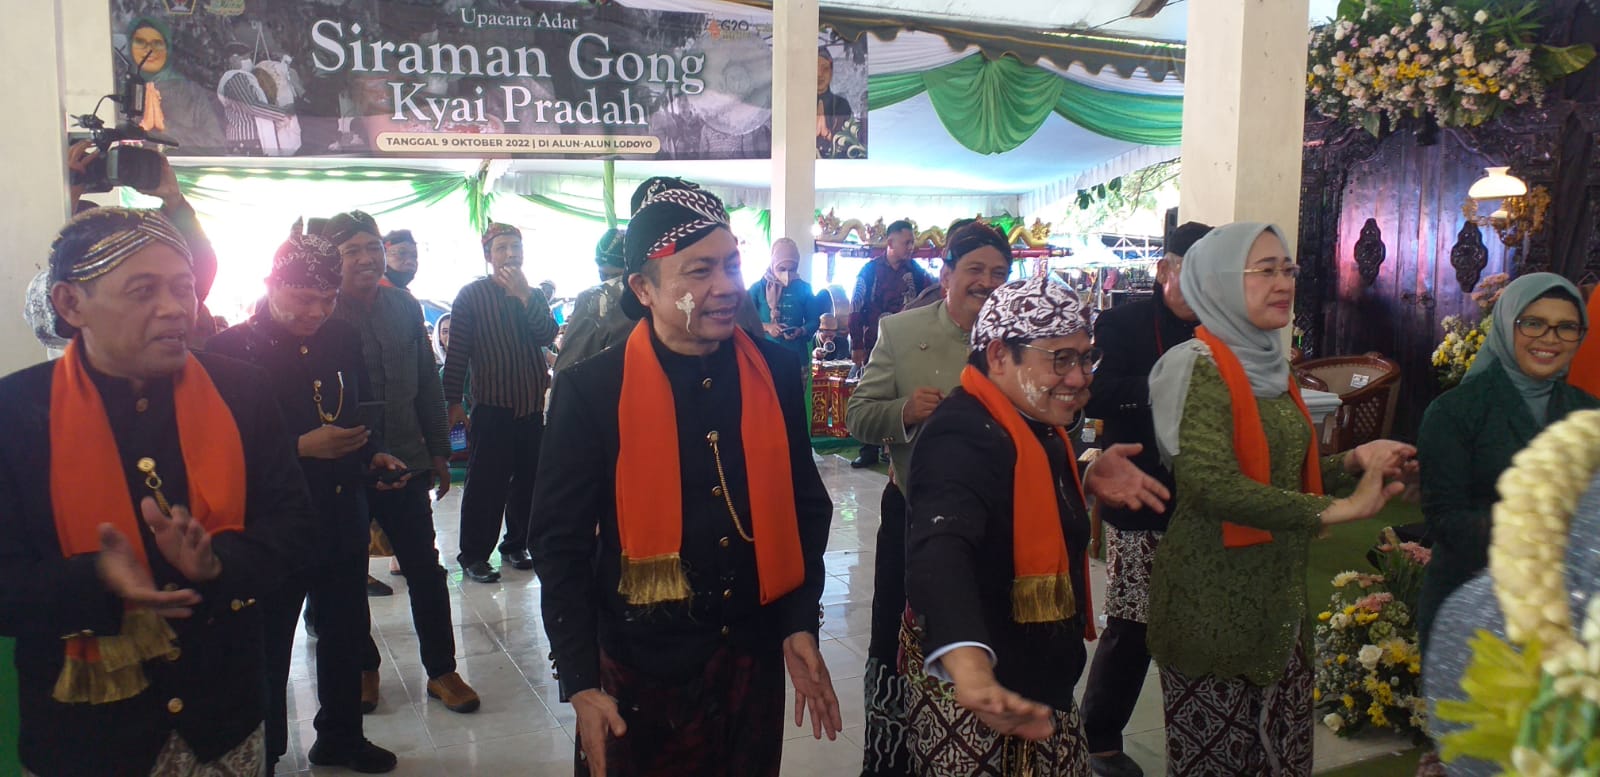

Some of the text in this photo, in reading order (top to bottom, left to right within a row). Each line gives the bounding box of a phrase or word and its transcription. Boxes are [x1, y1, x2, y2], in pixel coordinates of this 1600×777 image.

[460, 7, 577, 30] Upacara Adat
[311, 19, 705, 95] Siraman Gong
[387, 81, 648, 130] Kyai Pradah
[386, 137, 439, 146] TANGGAL
[442, 137, 448, 147] 9
[451, 138, 502, 147] OKTOBER
[506, 139, 530, 148] 2022
[538, 139, 549, 148] DI
[552, 140, 611, 149] ALUN-ALUN
[613, 140, 653, 149] LODOYO
